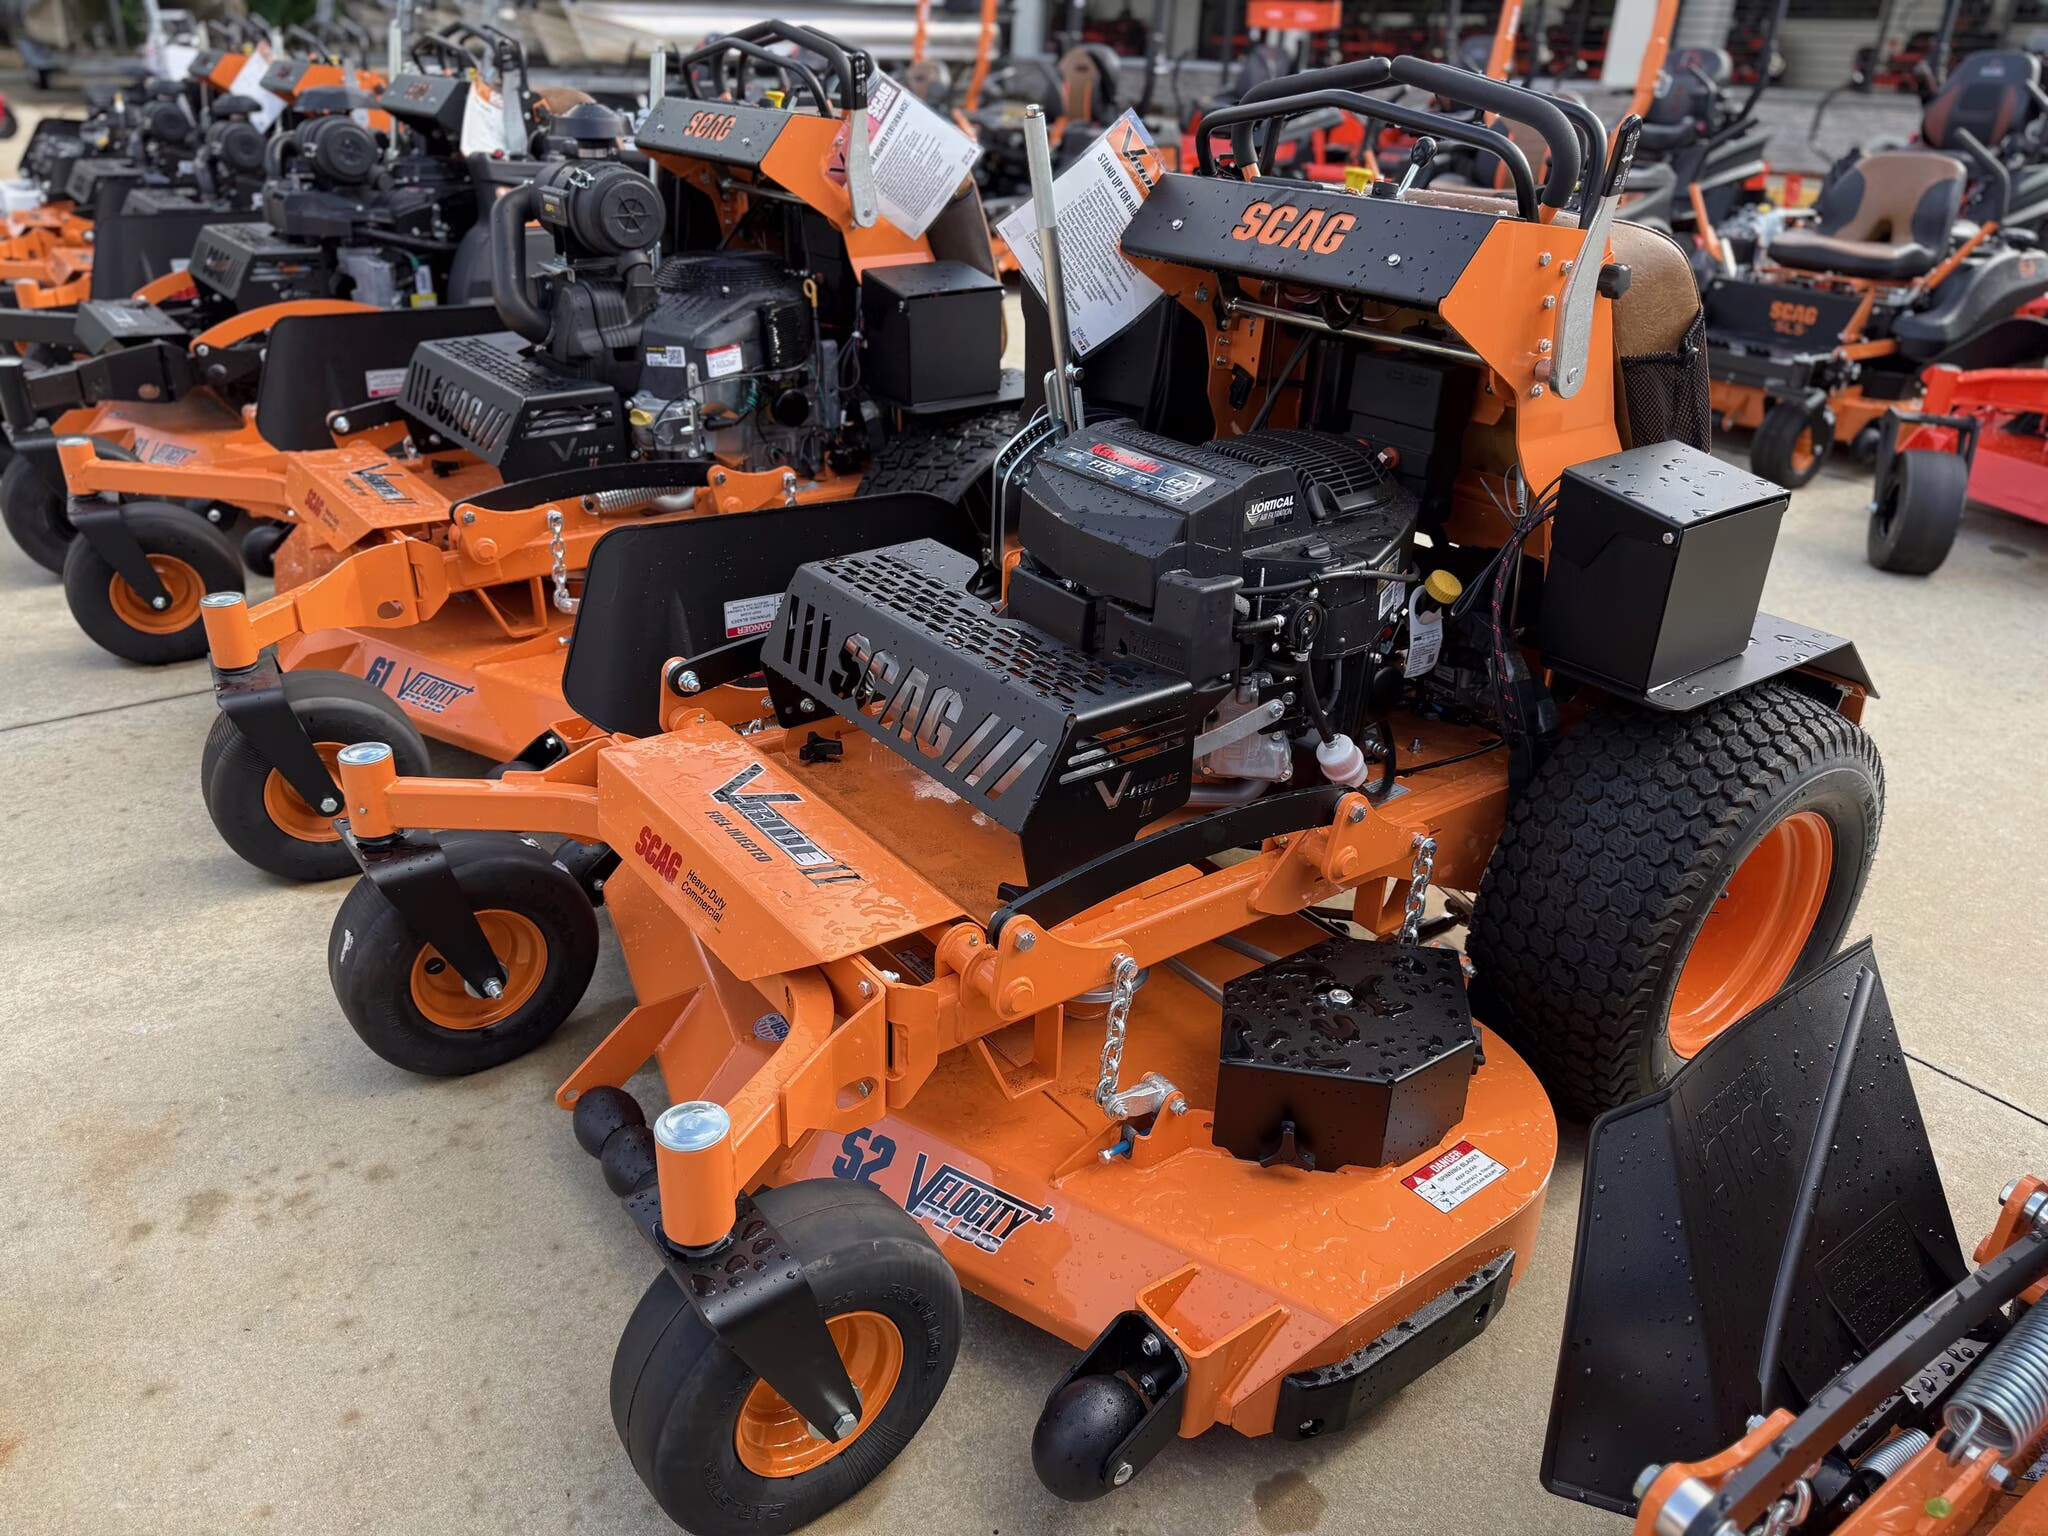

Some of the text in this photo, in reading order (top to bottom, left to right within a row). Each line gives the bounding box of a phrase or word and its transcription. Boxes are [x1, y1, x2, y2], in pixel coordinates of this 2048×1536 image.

[866, 82, 892, 118] SCAG
[681, 110, 736, 142] SCAG
[1096, 152, 1139, 217] STAND UP FOR HIG
[1231, 200, 1356, 255] SCAG
[424, 373, 484, 438] SCAG
[304, 488, 324, 518] SCAG
[1251, 495, 1294, 514] VORTICAL
[736, 621, 771, 634] DANGER
[364, 656, 397, 689] 61
[838, 632, 965, 760] SCAG
[634, 825, 683, 884] SCAG
[705, 810, 773, 863] FUEL-INJECTED
[680, 880, 724, 923] Commercial
[686, 869, 728, 911] Heavy-Duty
[770, 1020, 789, 1040] USA
[1430, 1150, 1463, 1173] DANGER
[1437, 1152, 1479, 1182] SPINNING BLADES
[911, 1201, 1004, 1254] PLUS
